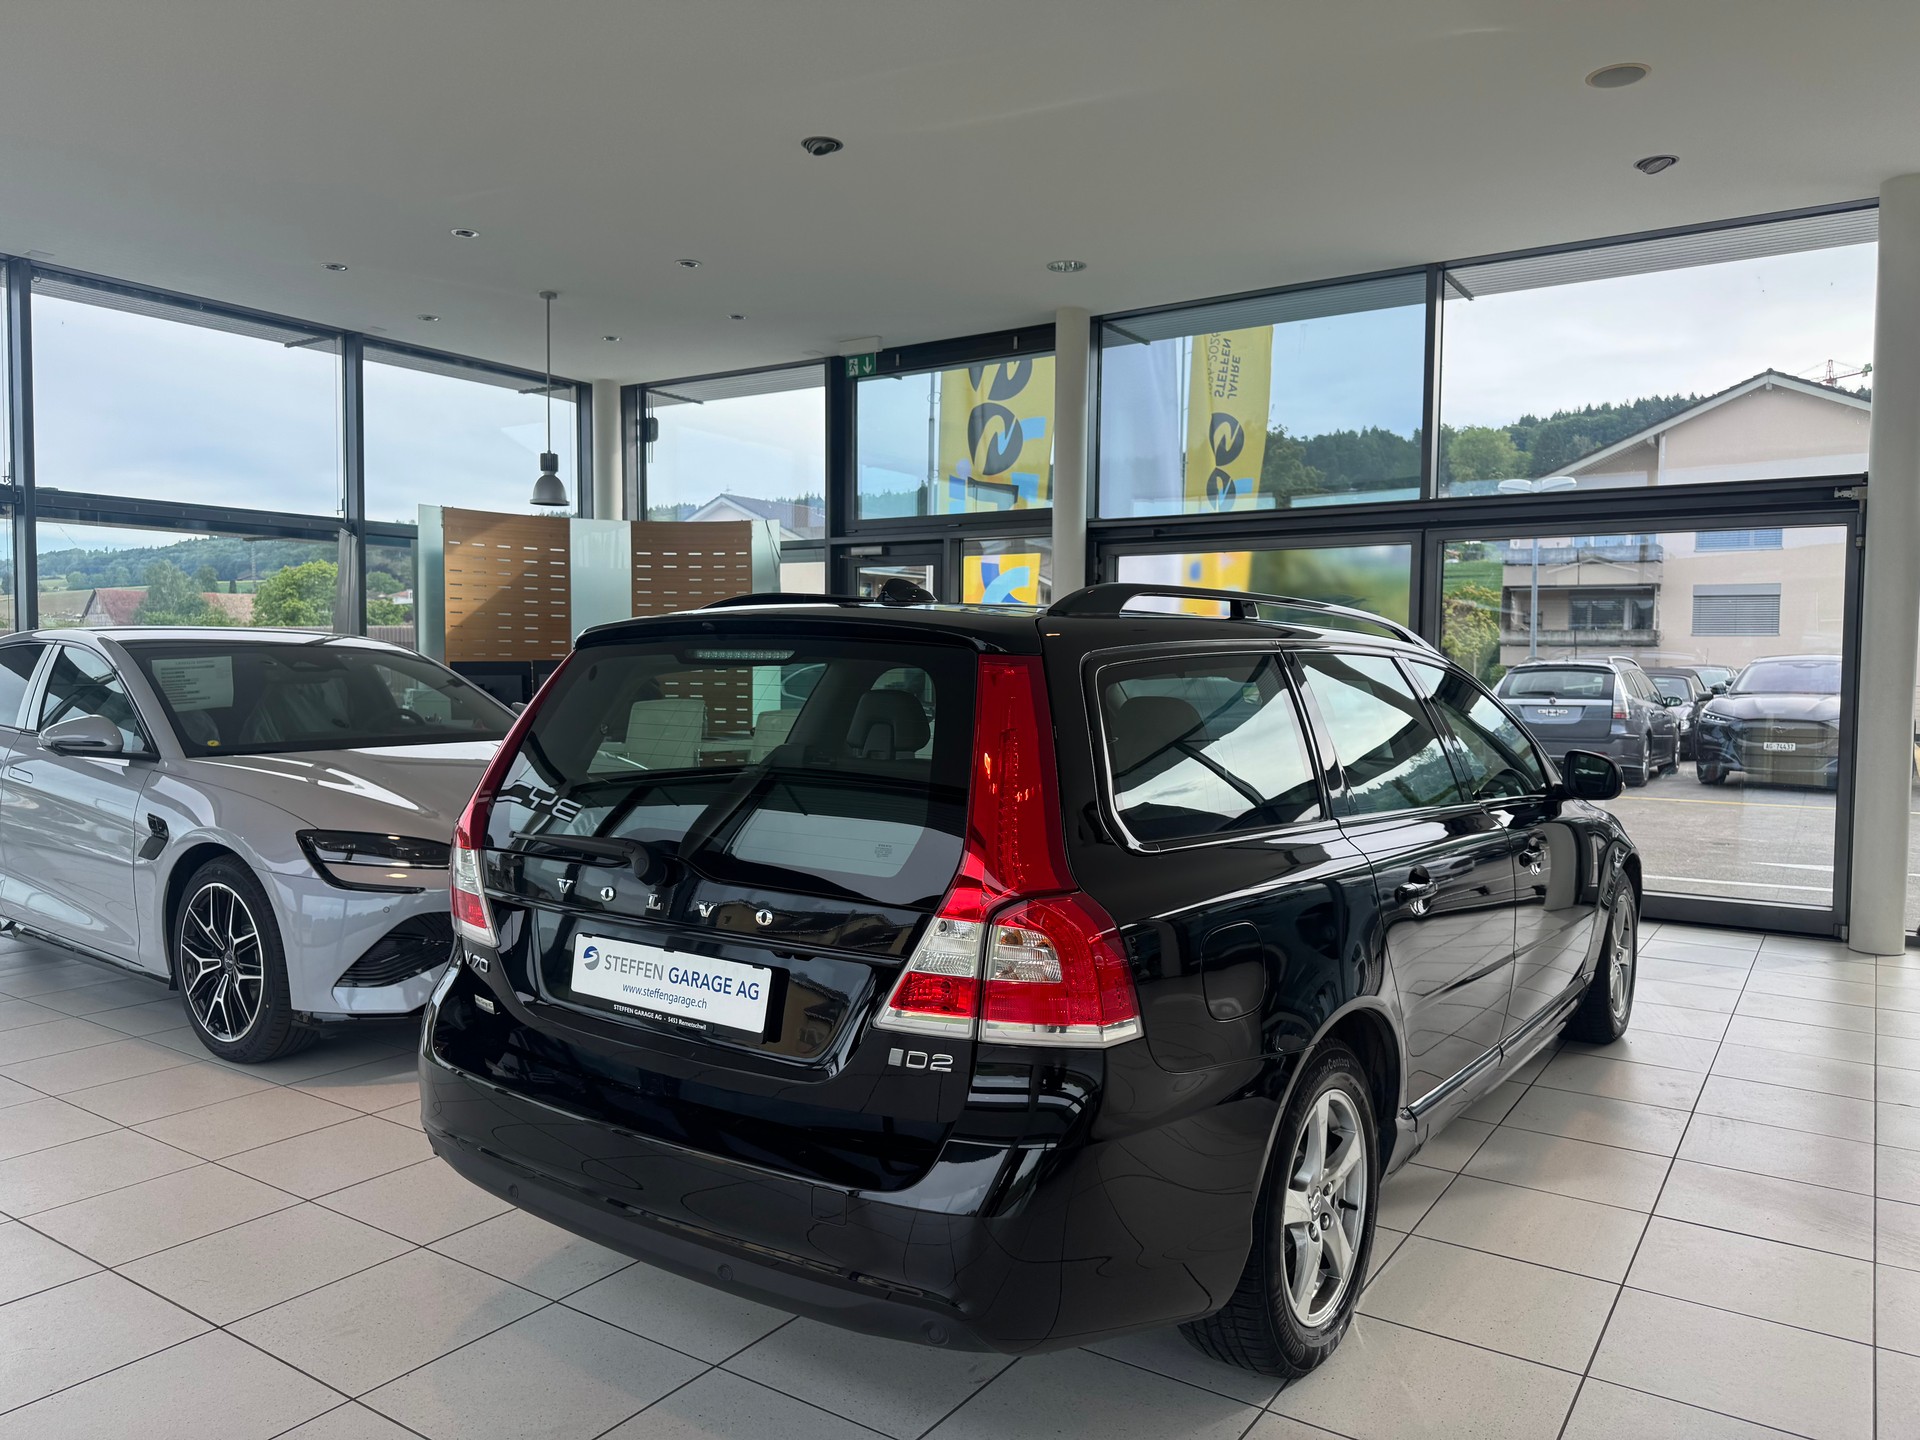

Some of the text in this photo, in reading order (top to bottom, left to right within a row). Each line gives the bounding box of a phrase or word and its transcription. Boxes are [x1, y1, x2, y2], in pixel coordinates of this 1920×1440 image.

[556, 878, 773, 926] VOLVO
[464, 950, 489, 973] V70
[604, 954, 760, 1001] STEFFEN GARAGE AG
[622, 983, 708, 1010] www.steffengarage.ch
[613, 1004, 634, 1014] STEFFEN
[634, 1009, 654, 1019] GARAGE
[906, 1050, 954, 1073] D2
